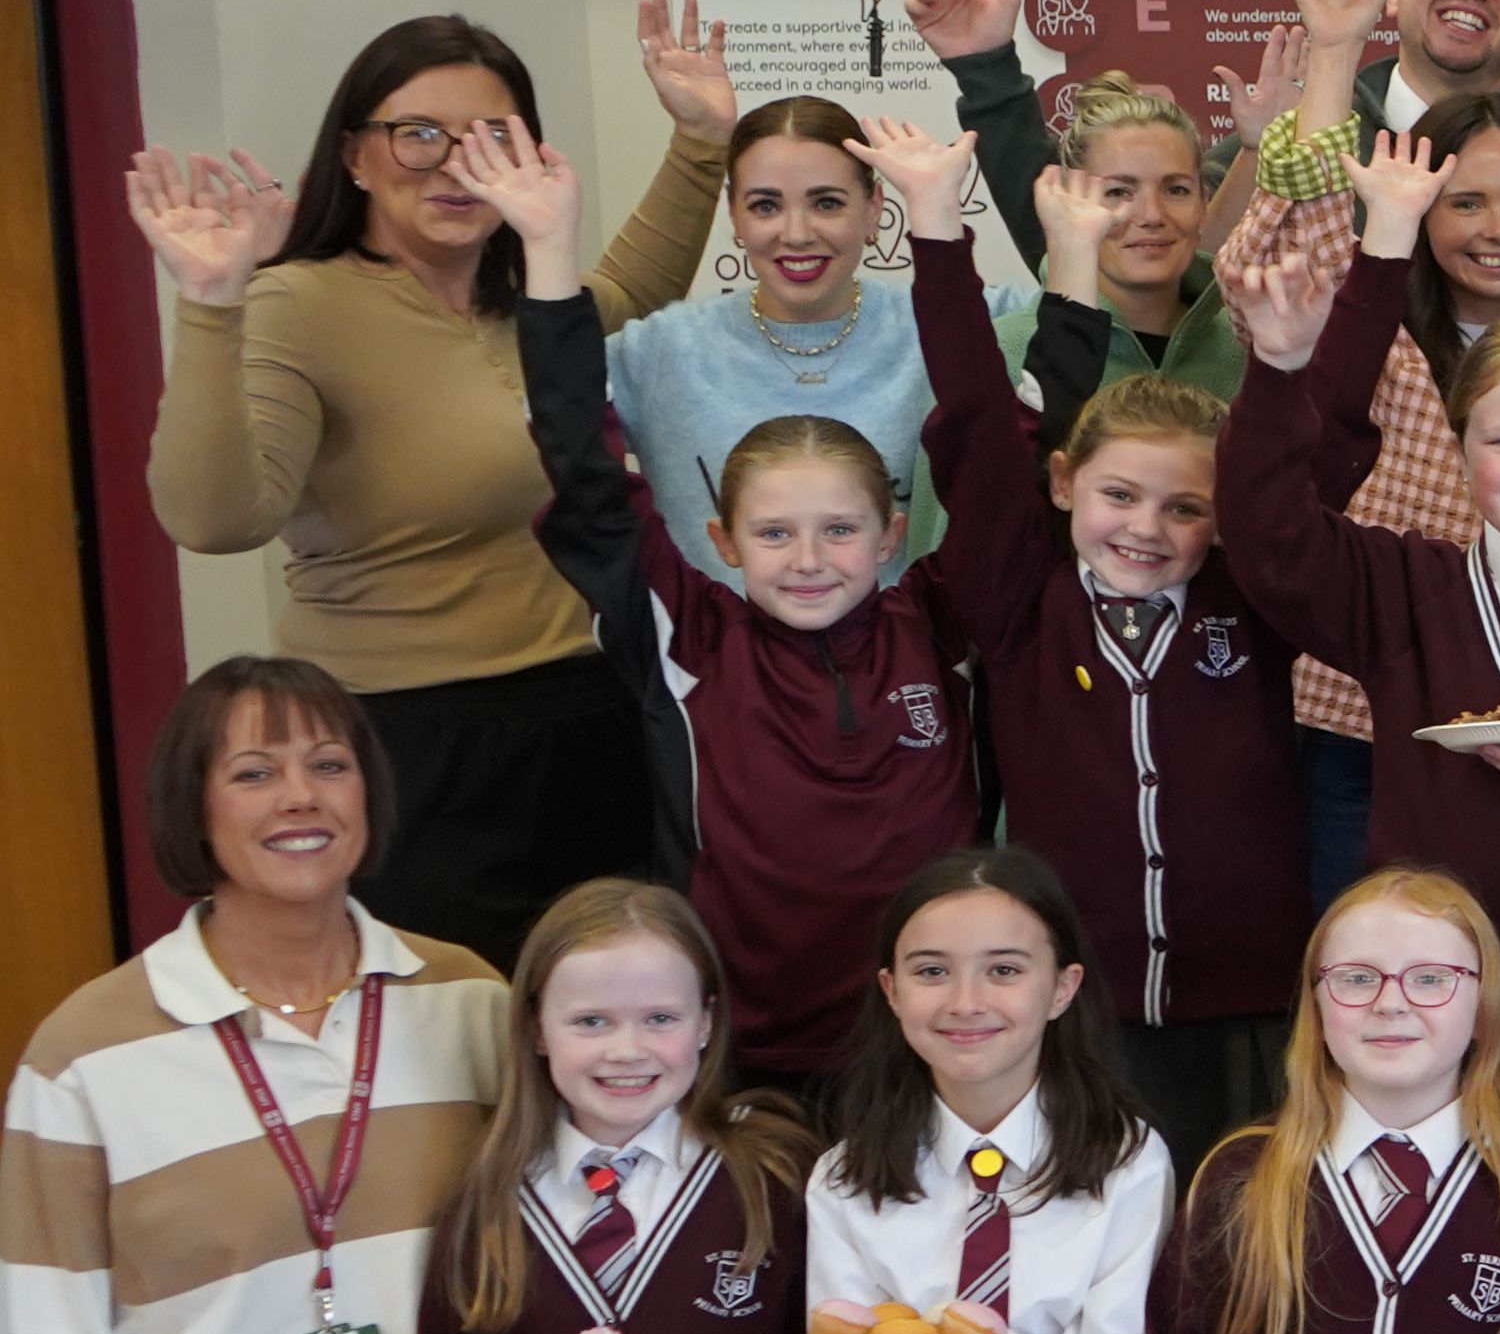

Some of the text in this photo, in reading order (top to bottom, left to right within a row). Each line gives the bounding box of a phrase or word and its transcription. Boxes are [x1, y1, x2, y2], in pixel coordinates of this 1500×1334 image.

[1204, 9, 1228, 24] We
[772, 23, 781, 34] a
[785, 20, 862, 36] supportive
[1206, 28, 1251, 43] about
[801, 39, 926, 53] where child
[760, 58, 846, 75] encouraged
[851, 61, 871, 72] an
[786, 77, 932, 94] in a changing world.
[1210, 115, 1234, 128] We
[1460, 1252, 1478, 1264] ST.
[1447, 1293, 1484, 1323] PRIMARY
